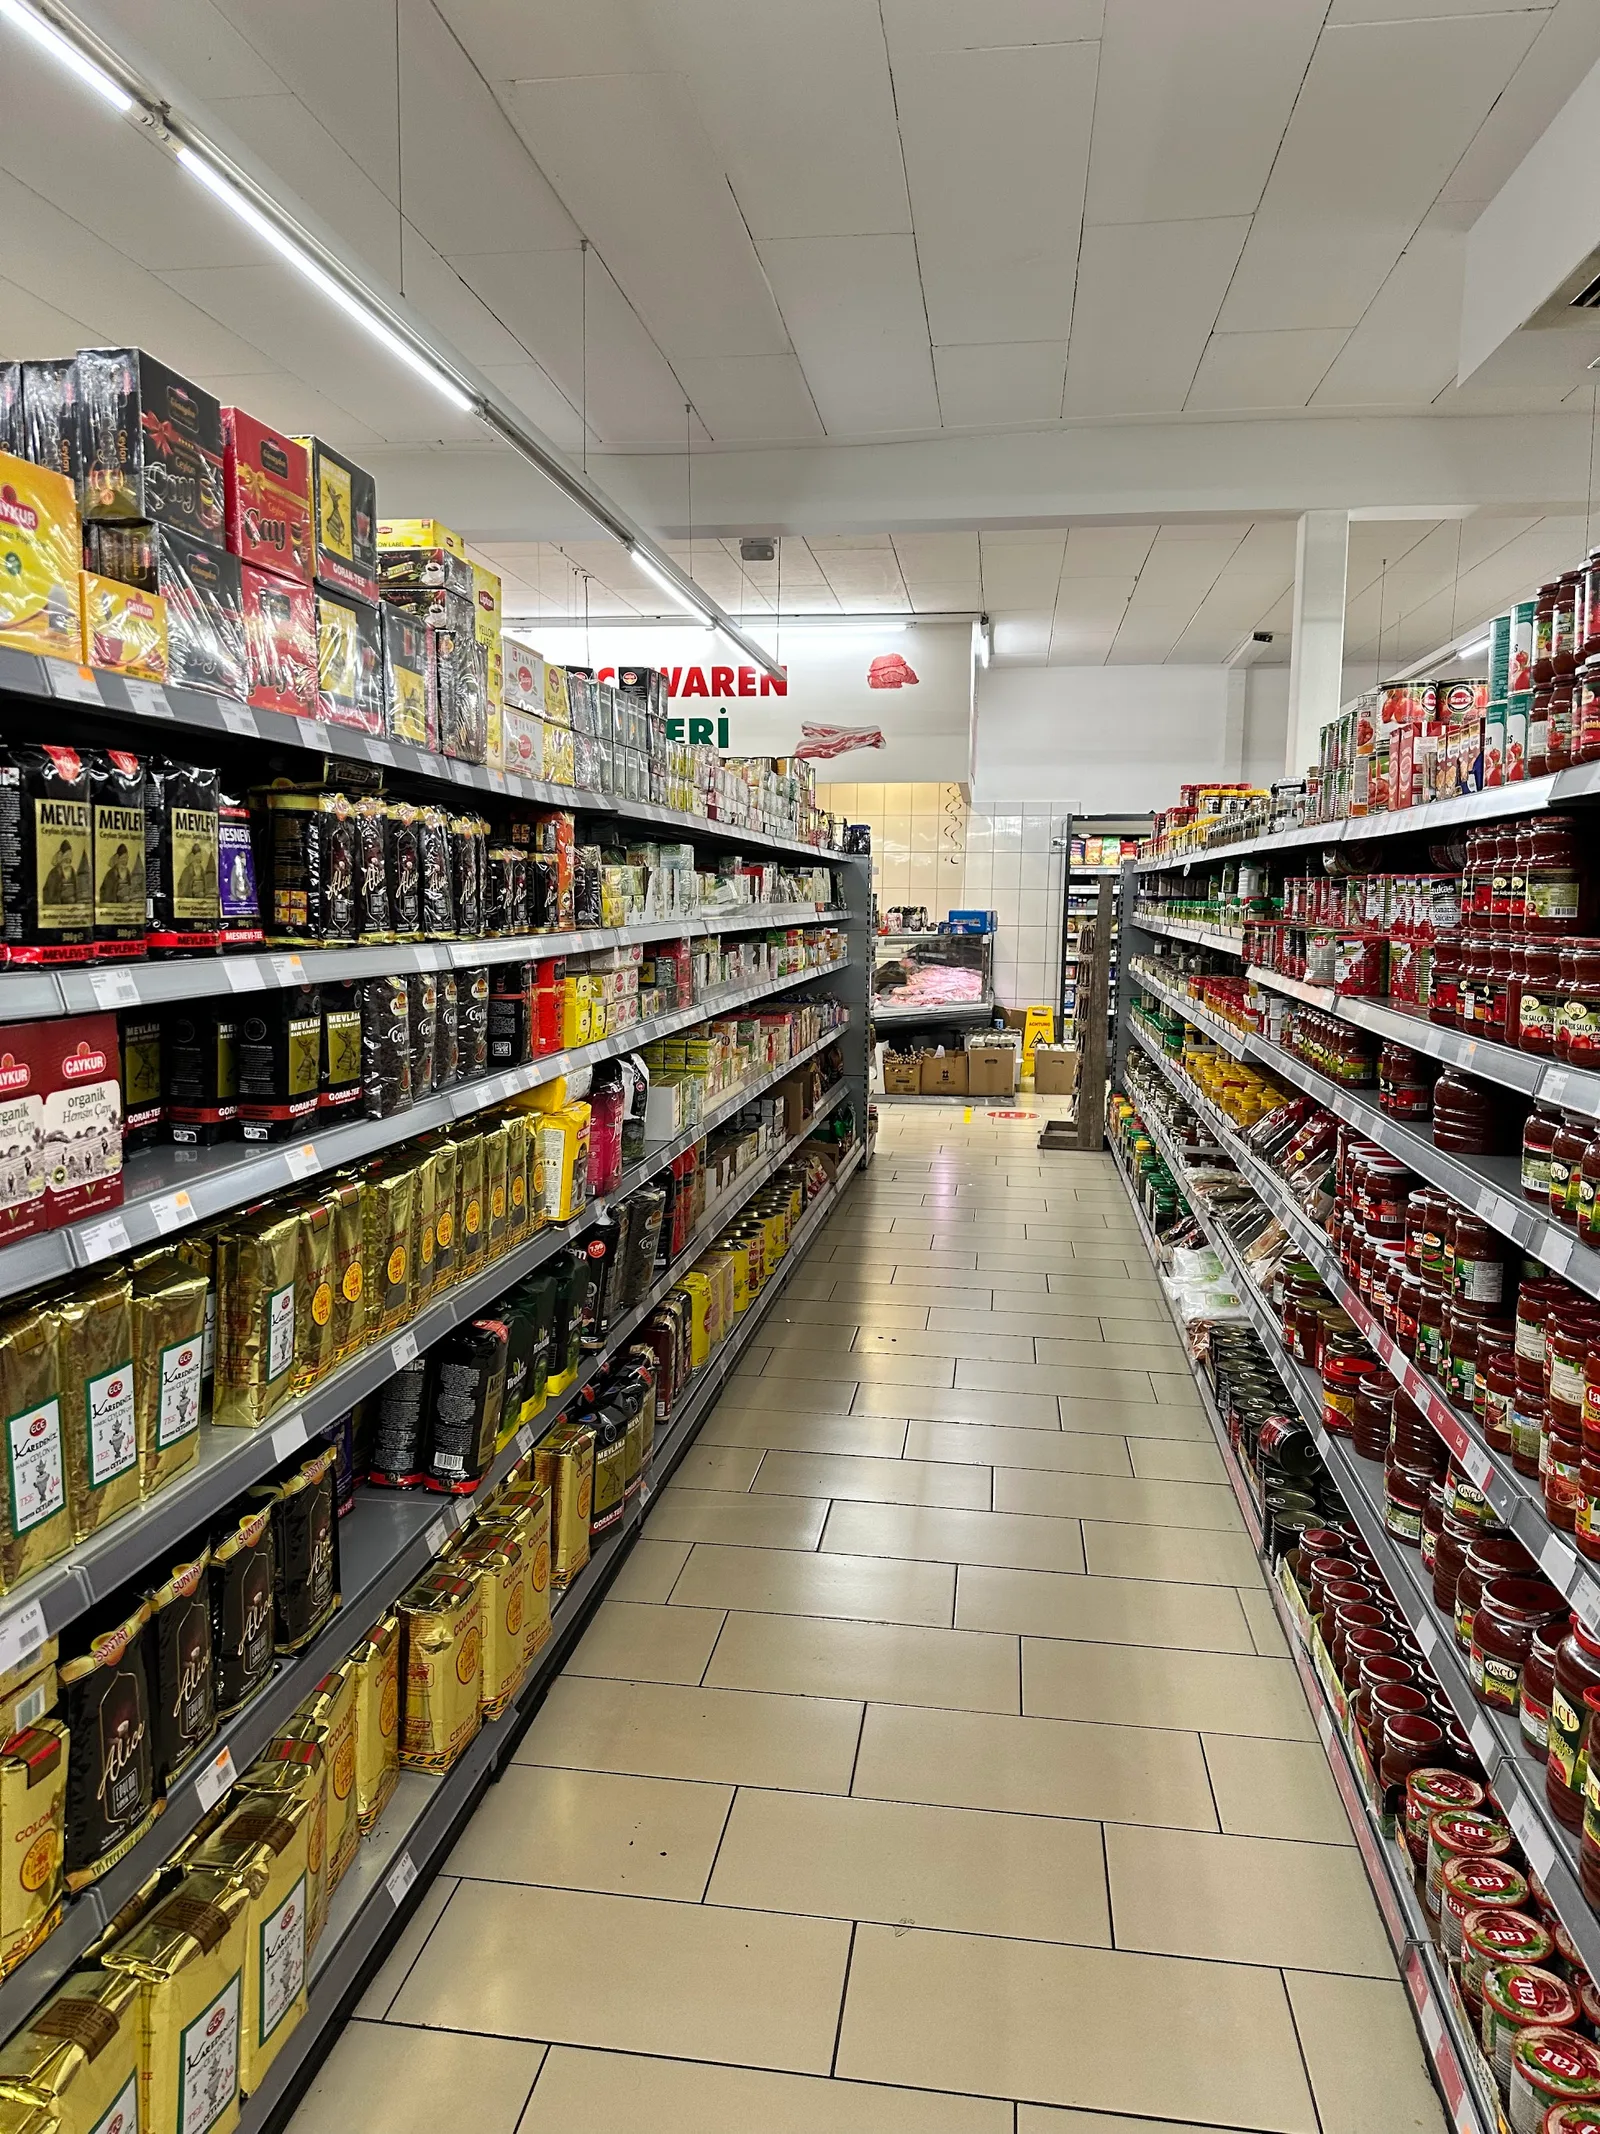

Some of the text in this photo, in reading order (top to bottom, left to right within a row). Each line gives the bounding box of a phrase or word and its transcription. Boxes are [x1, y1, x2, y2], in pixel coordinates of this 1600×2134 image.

[117, 428, 129, 465] Ceylon
[332, 562, 368, 588] GORAN-TEE
[225, 930, 263, 941] MESNEVI-TEE
[65, 1055, 104, 1077] ÇAYKUR
[67, 1087, 106, 1108] organik
[329, 1087, 360, 1102] GORAN-TEE
[62, 1106, 94, 1125] Hemşin
[289, 1098, 318, 1115] GORAN-TEE
[179, 1350, 194, 1366] ECE
[107, 1380, 124, 1397] ECE
[29, 1418, 47, 1436] ECE
[238, 1513, 266, 1546] SUNTAT
[172, 1562, 203, 1594] SUNTAT
[25, 1608, 38, 1622] 5.99
[94, 1626, 129, 1662] SUNTAT
[1487, 1661, 1518, 1680] ÖNCÜ
[1429, 1780, 1462, 1798] tat
[1454, 1821, 1488, 1838] tat
[1469, 1876, 1506, 1889] tat
[1491, 1929, 1528, 1944] tat
[1514, 1978, 1536, 2007] tat
[1538, 2048, 1584, 2077] tat
